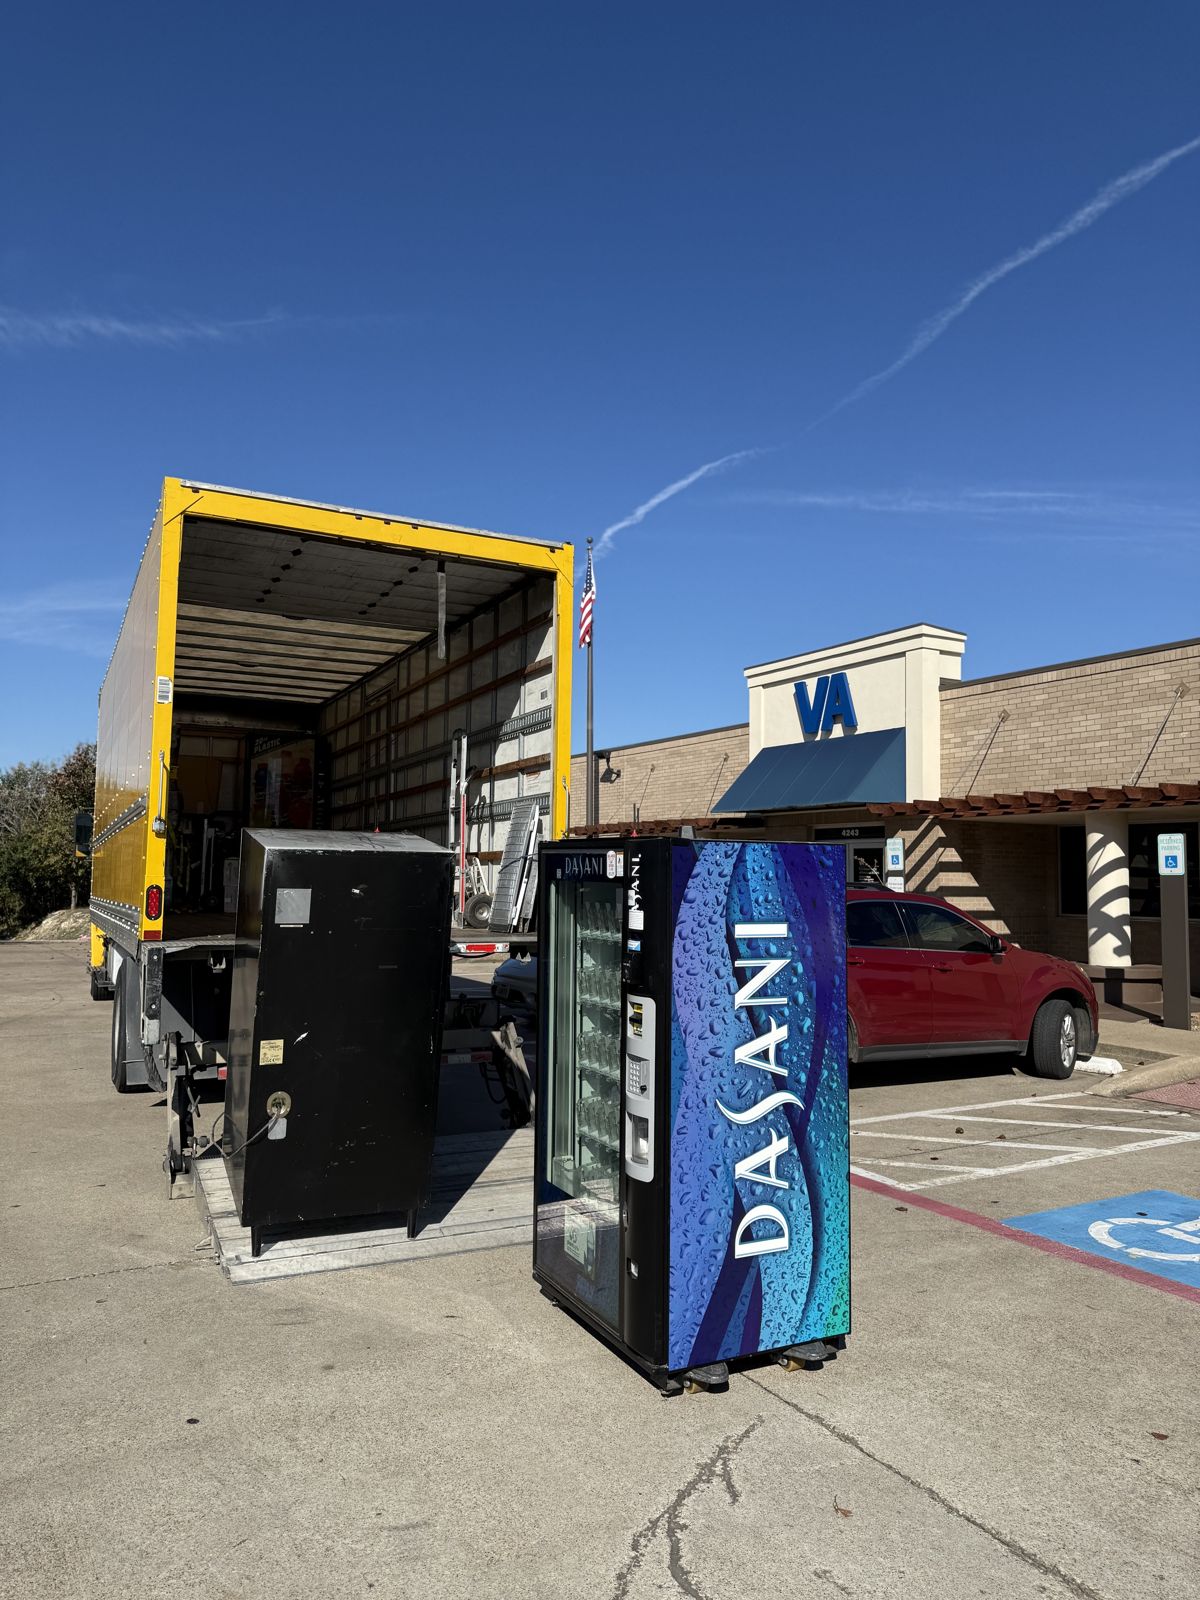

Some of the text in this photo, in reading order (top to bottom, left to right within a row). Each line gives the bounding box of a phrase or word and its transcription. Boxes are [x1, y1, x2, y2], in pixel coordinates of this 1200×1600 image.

[794, 672, 858, 733] VA
[565, 856, 603, 878] DASANI
[716, 922, 805, 1259] DASANI
